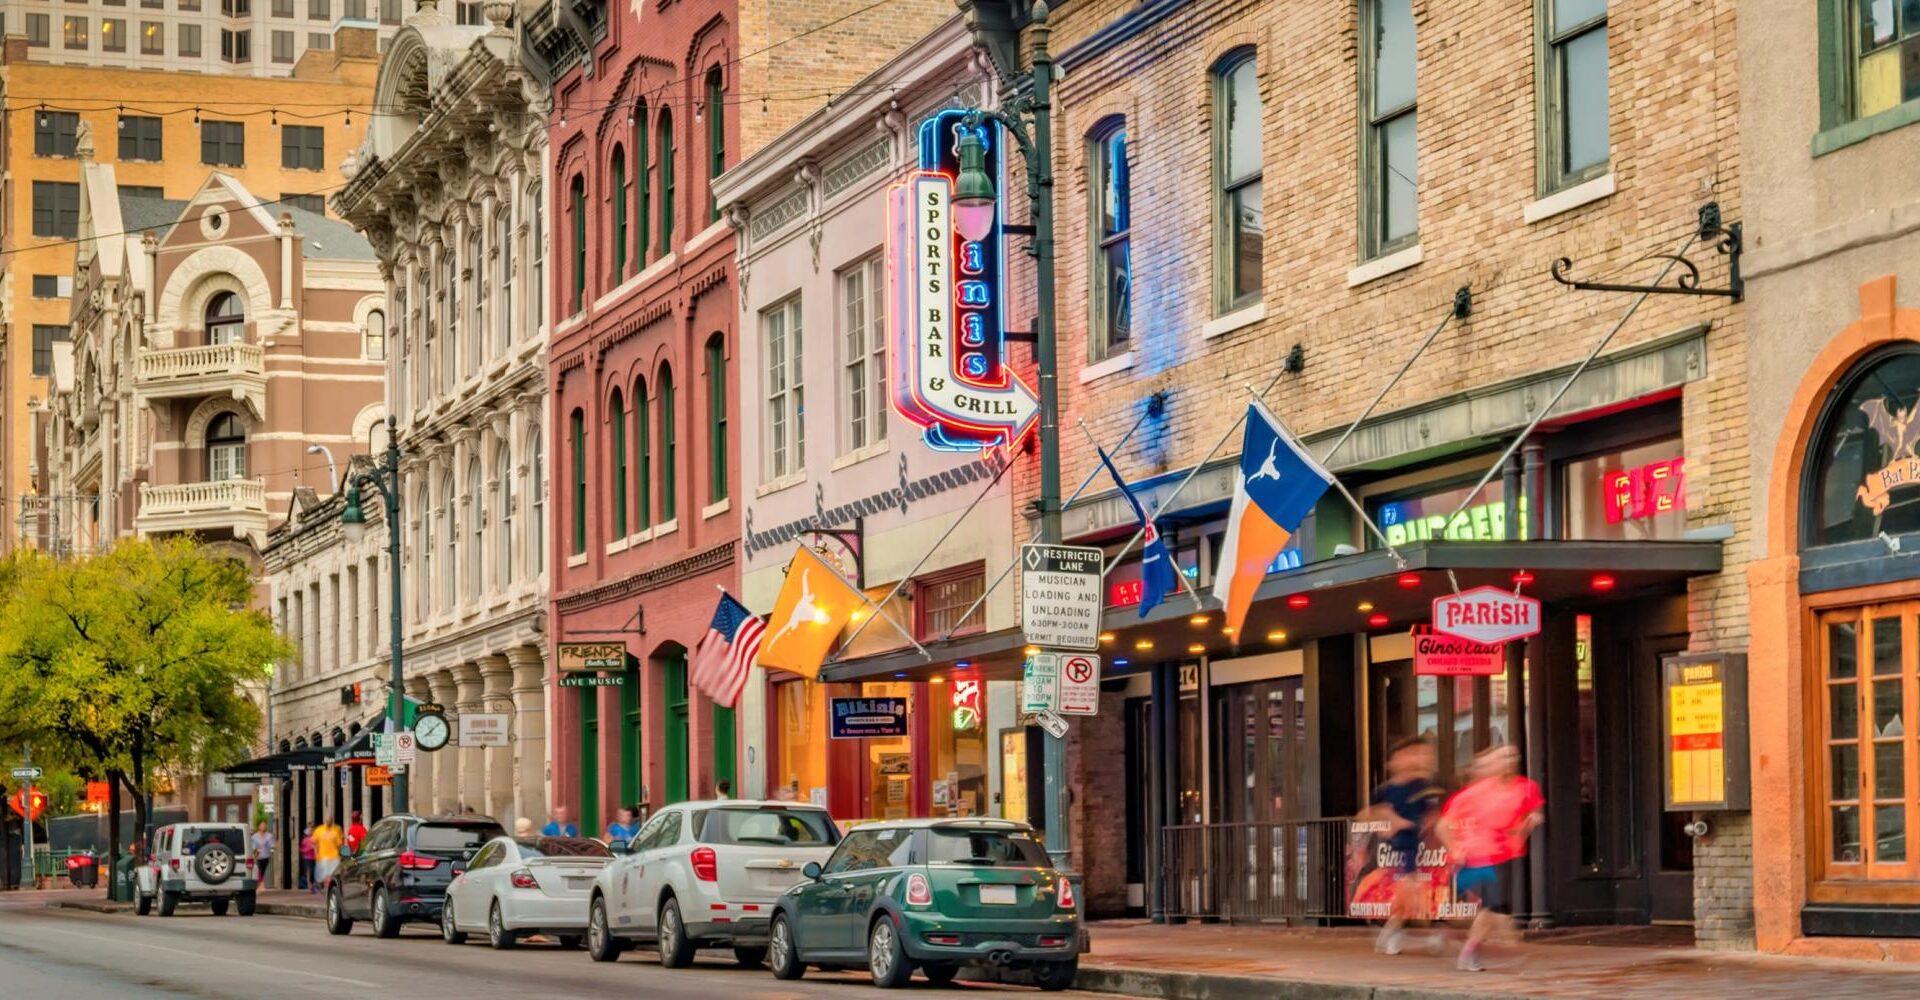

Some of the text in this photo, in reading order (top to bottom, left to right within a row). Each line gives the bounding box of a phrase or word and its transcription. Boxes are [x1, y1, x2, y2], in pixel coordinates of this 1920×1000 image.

[927, 191, 945, 391] SPORTS BAR &
[954, 394, 1018, 415] GRILL
[1881, 468, 1904, 488] Bat
[1043, 549, 1100, 563] RESTRICTED
[1059, 561, 1084, 572] LANE
[1038, 575, 1086, 586] MUSICIAN
[1025, 590, 1098, 603] LOADING AND
[1032, 605, 1091, 618] UNLOADING
[1025, 632, 1096, 646] PERMIT REQUIRED
[561, 646, 624, 659] FRIENDS
[1418, 638, 1463, 656] Gino's
[560, 677, 624, 686] LIVE MUSIC
[1180, 666, 1196, 686] 14
[835, 700, 905, 717] Bikinis
[1415, 841, 1448, 868] East
